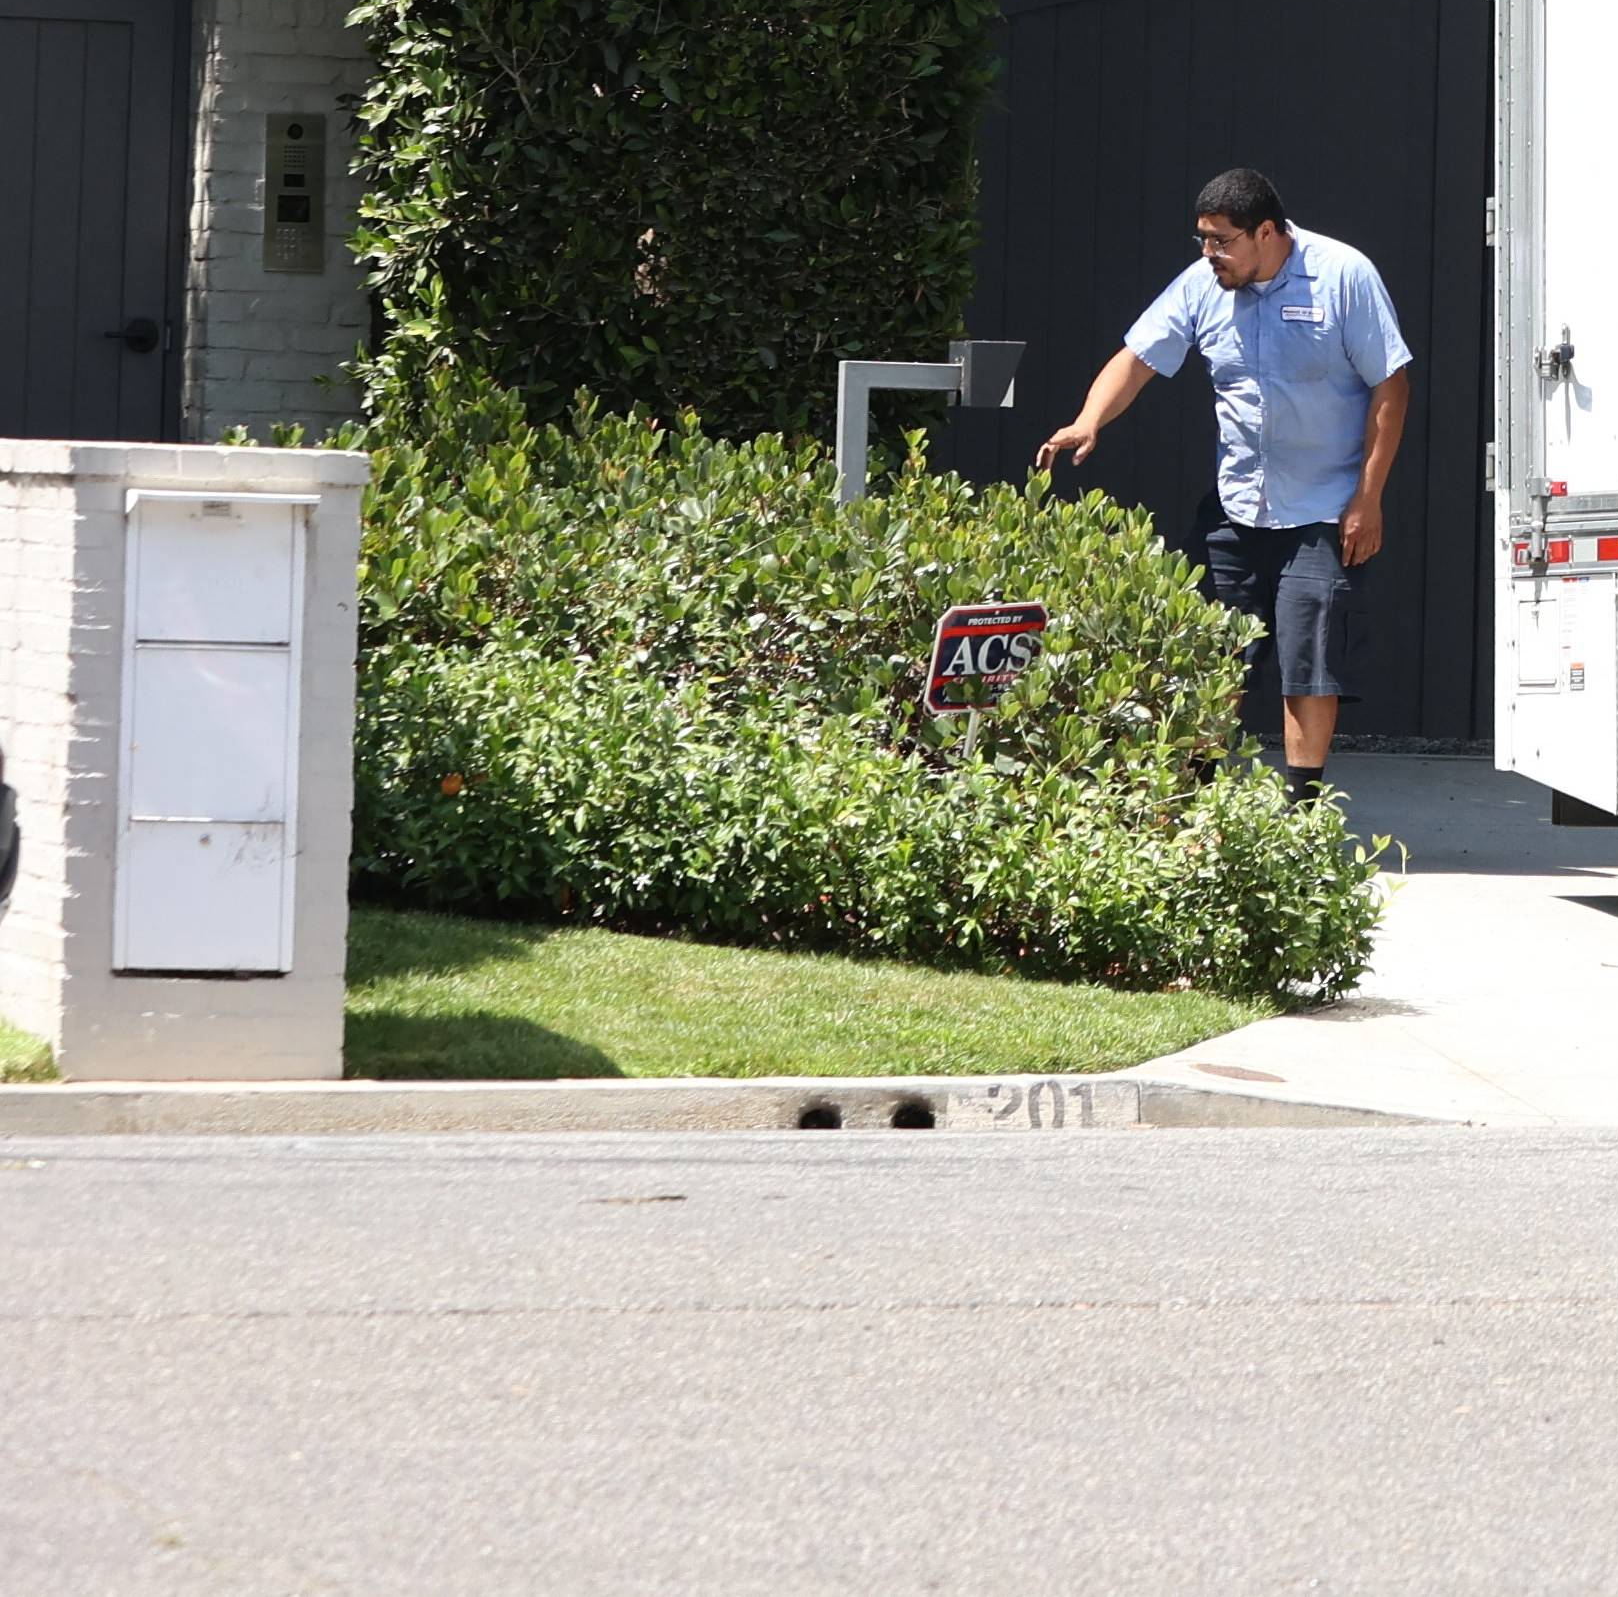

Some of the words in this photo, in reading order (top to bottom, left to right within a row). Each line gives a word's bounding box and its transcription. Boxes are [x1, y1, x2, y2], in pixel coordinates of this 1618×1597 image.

[968, 616, 1011, 626] PROTECTED
[1012, 615, 1023, 624] BY
[942, 632, 1034, 677] ACS
